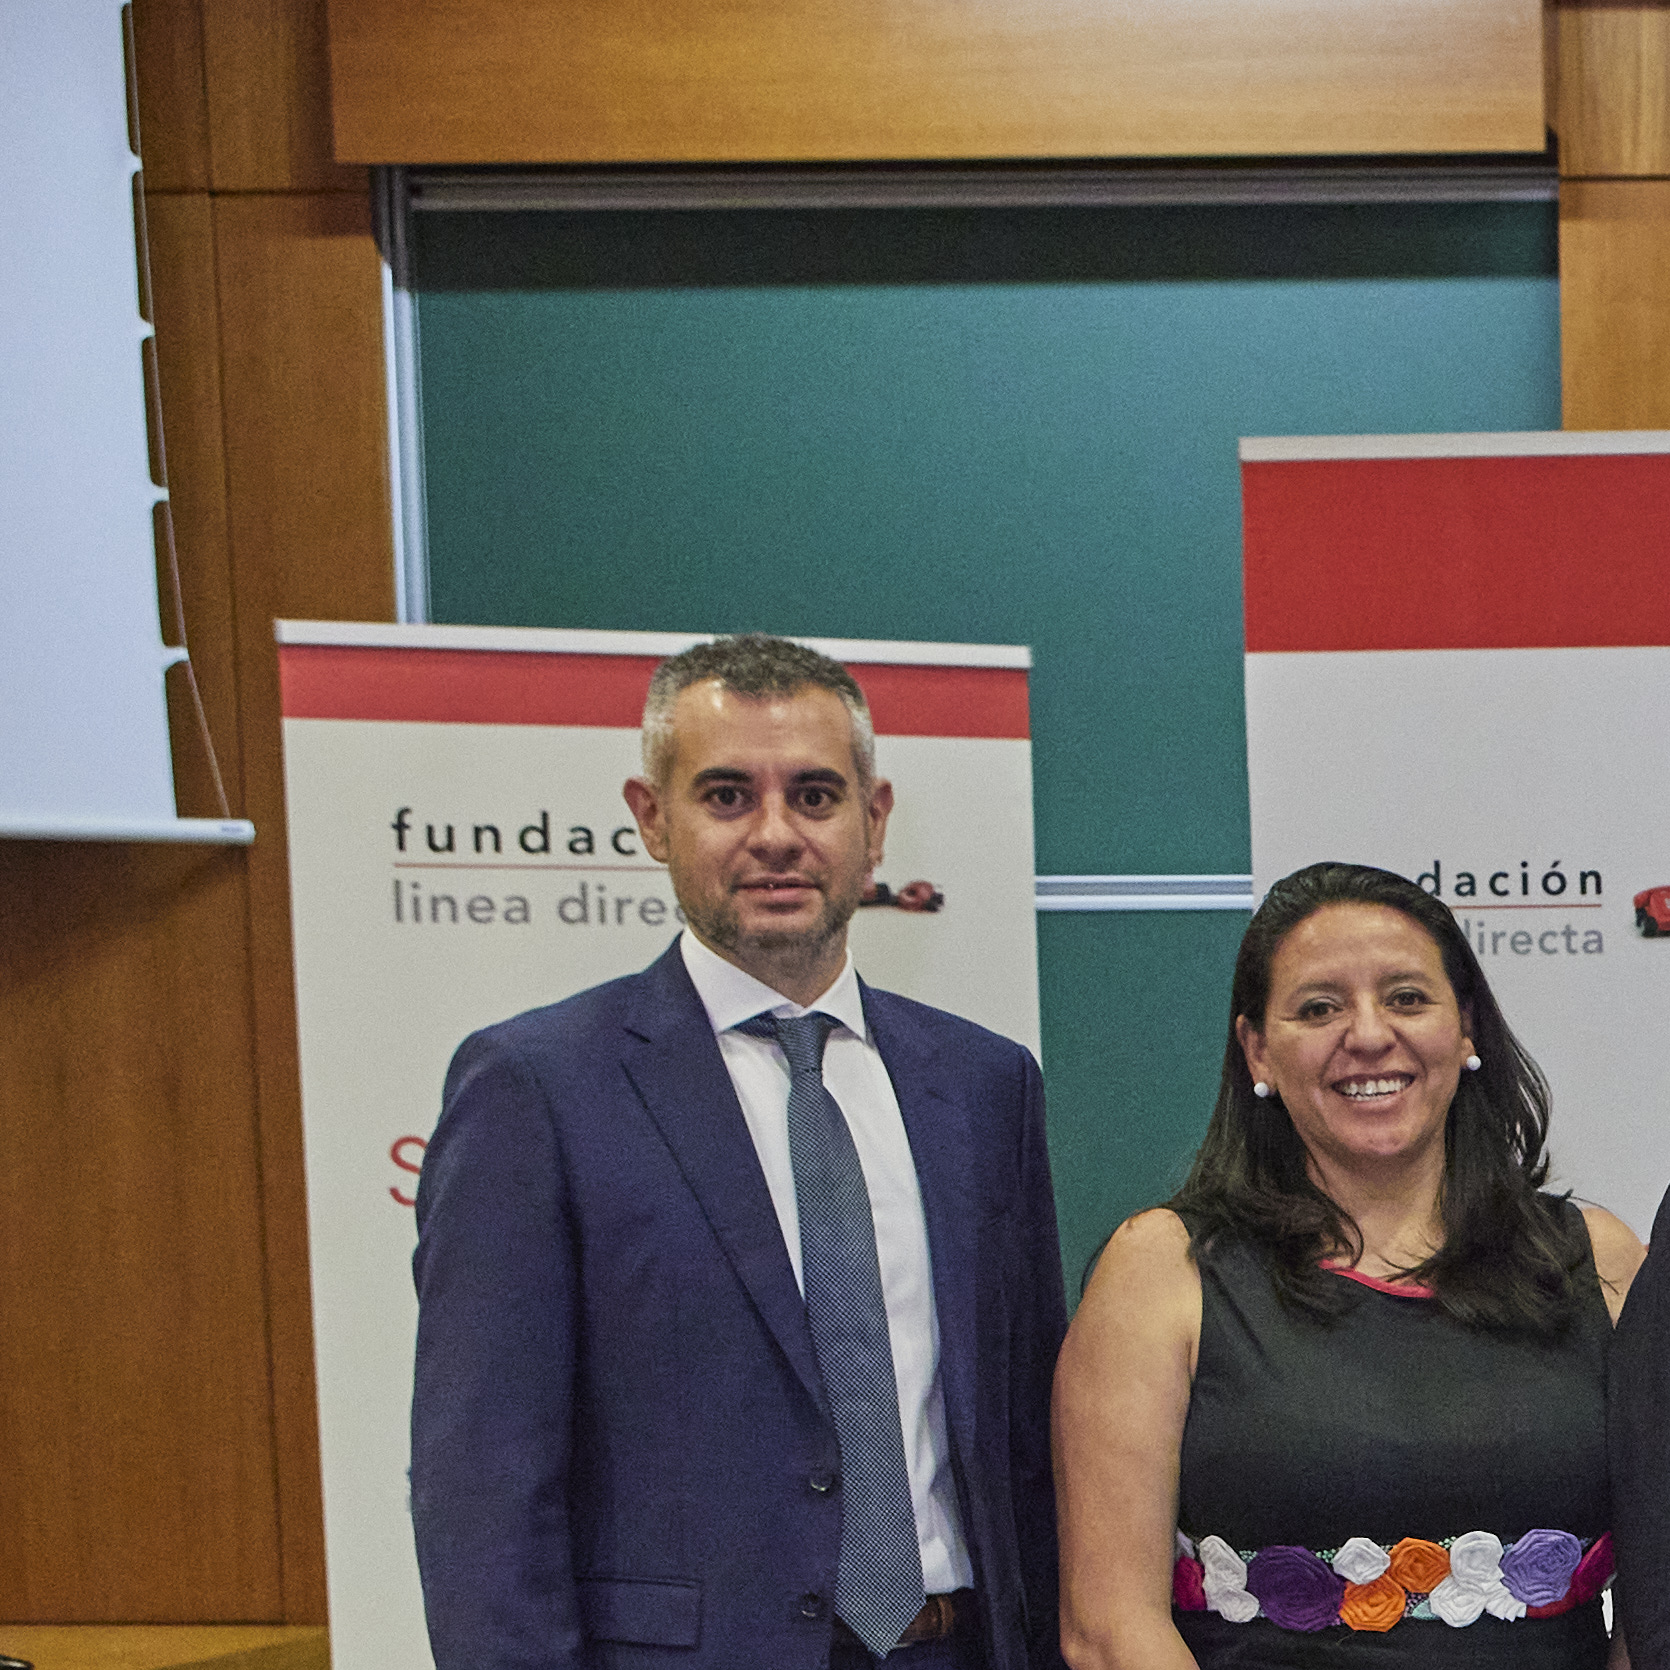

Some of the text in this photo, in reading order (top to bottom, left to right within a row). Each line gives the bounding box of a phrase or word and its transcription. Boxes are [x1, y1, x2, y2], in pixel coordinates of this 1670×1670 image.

[392, 807, 637, 855] fundac
[1416, 860, 1603, 896] dación
[393, 879, 686, 926] linea dire
